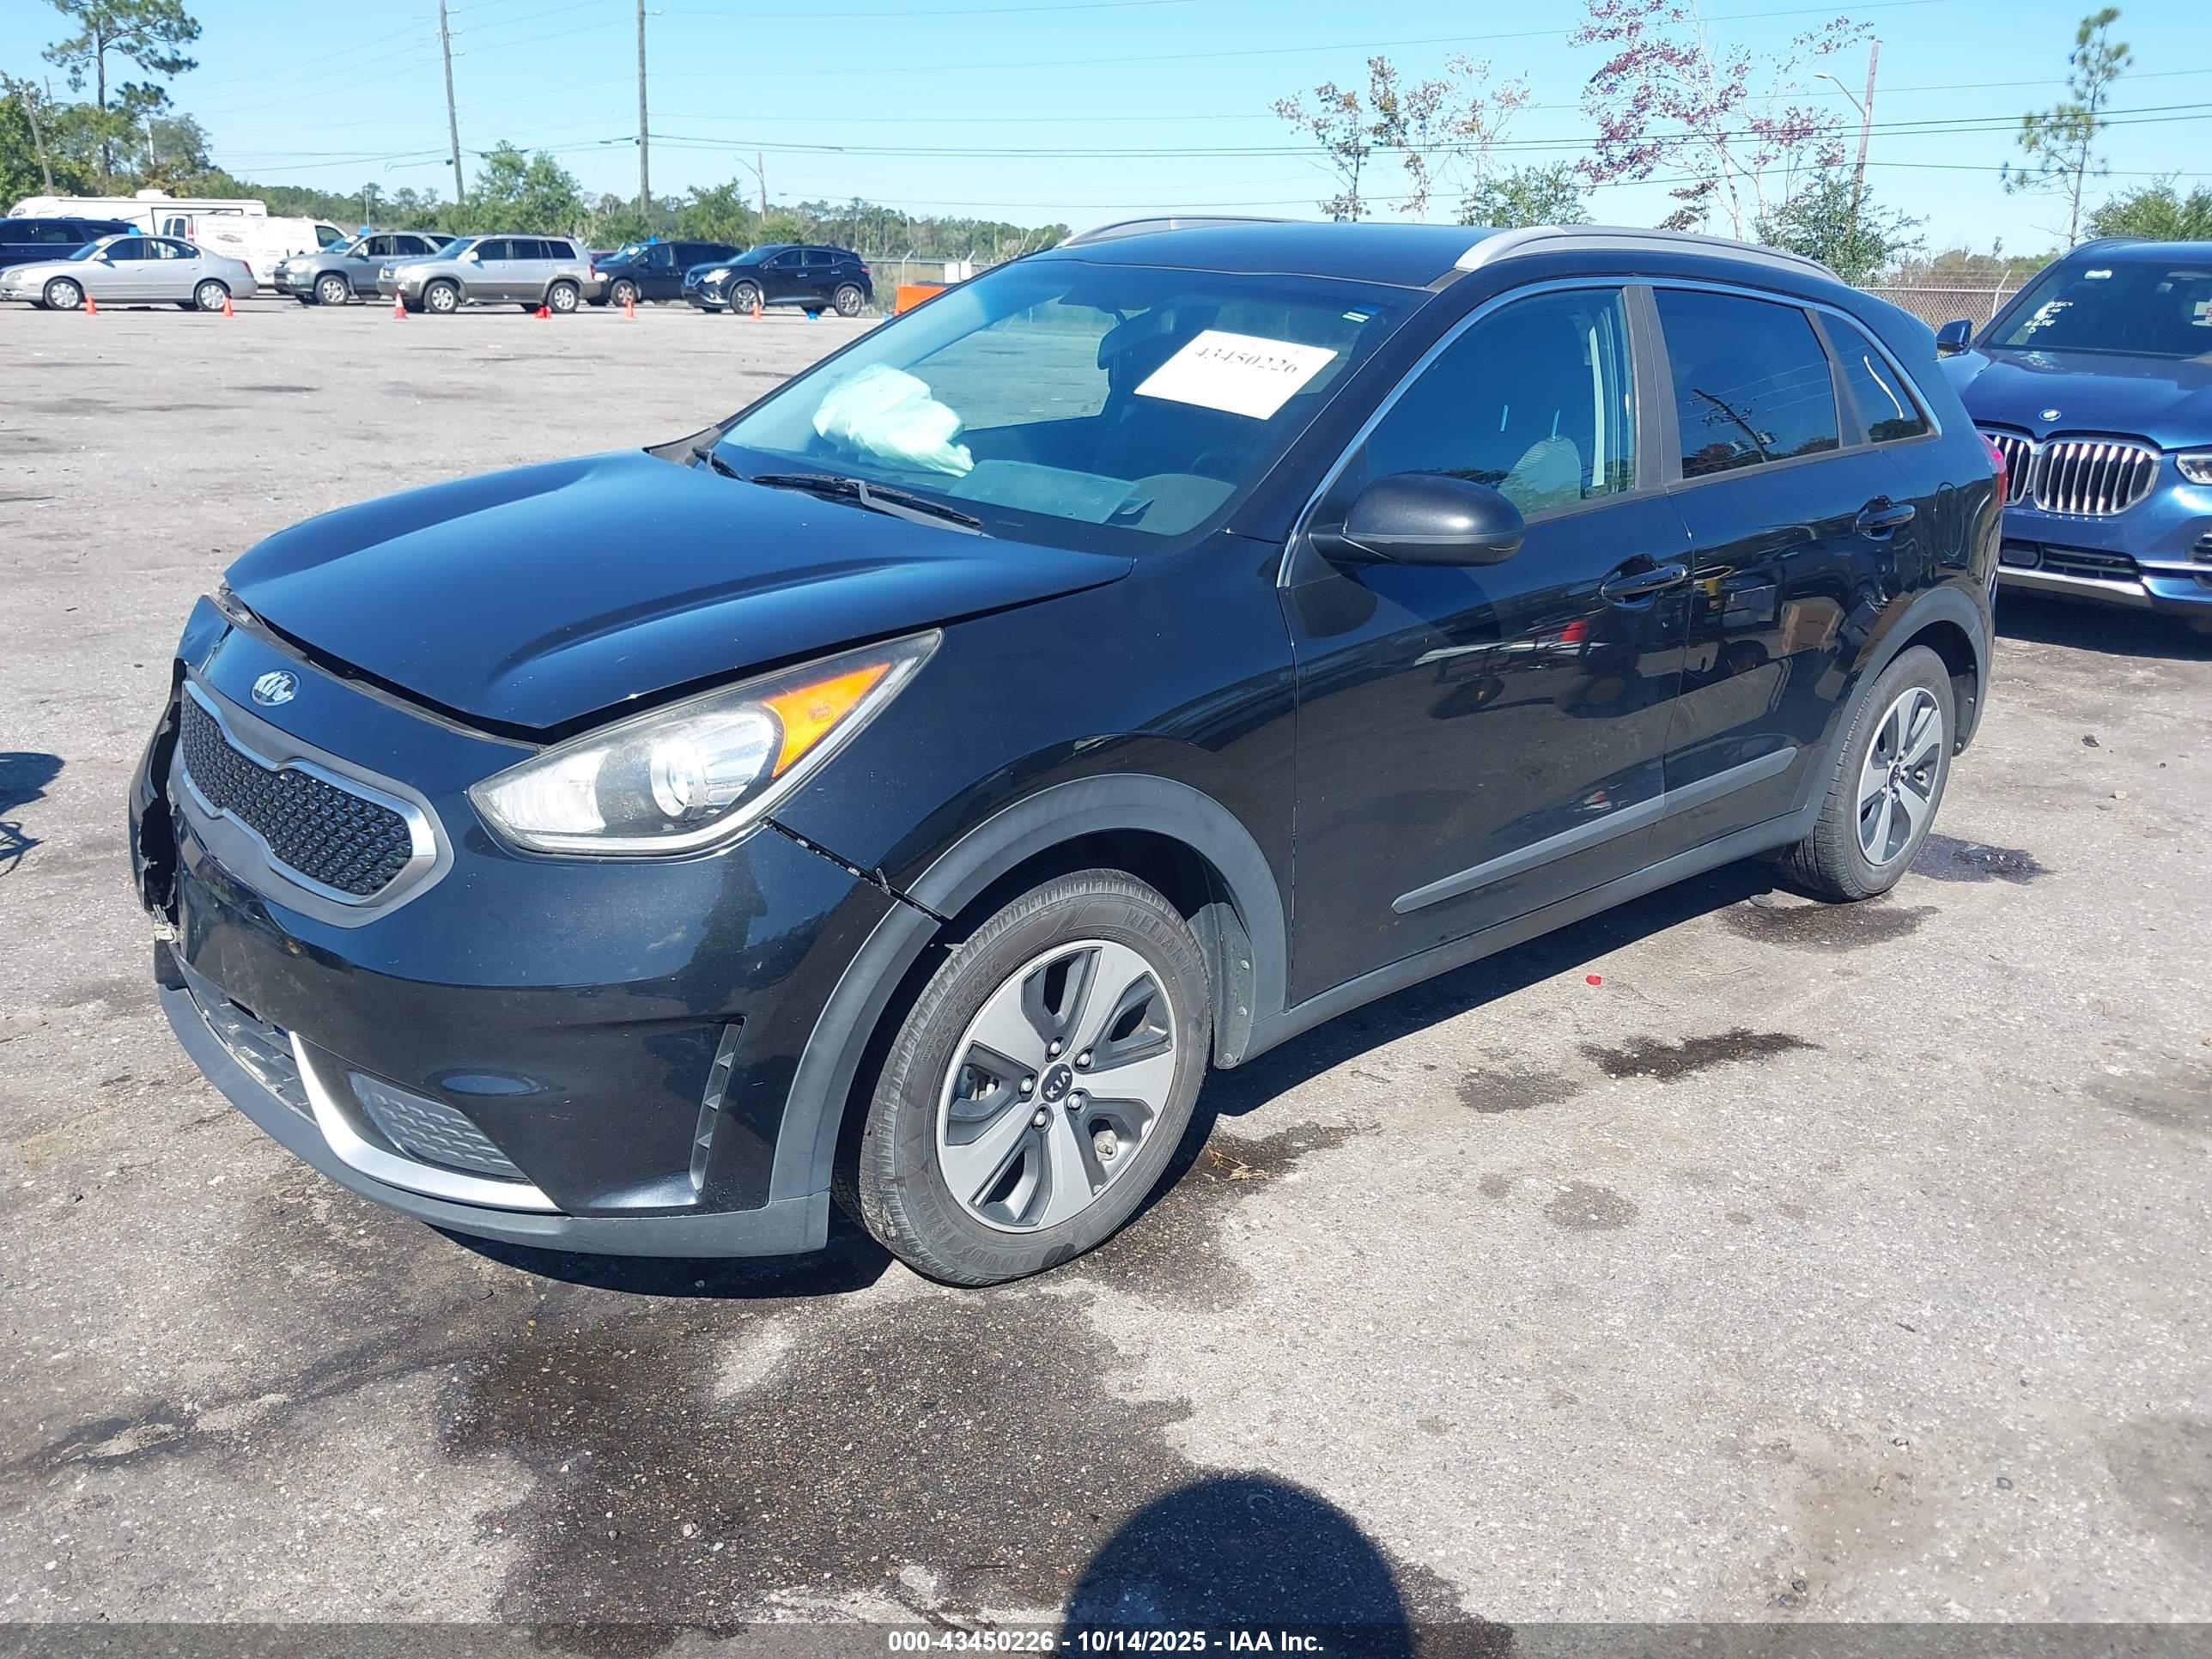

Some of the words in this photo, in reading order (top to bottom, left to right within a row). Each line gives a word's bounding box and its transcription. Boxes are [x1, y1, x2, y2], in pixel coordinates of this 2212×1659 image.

[1195, 347, 1297, 374] 43450226
[253, 671, 294, 702] KIA
[1045, 1071, 1072, 1099] KIA
